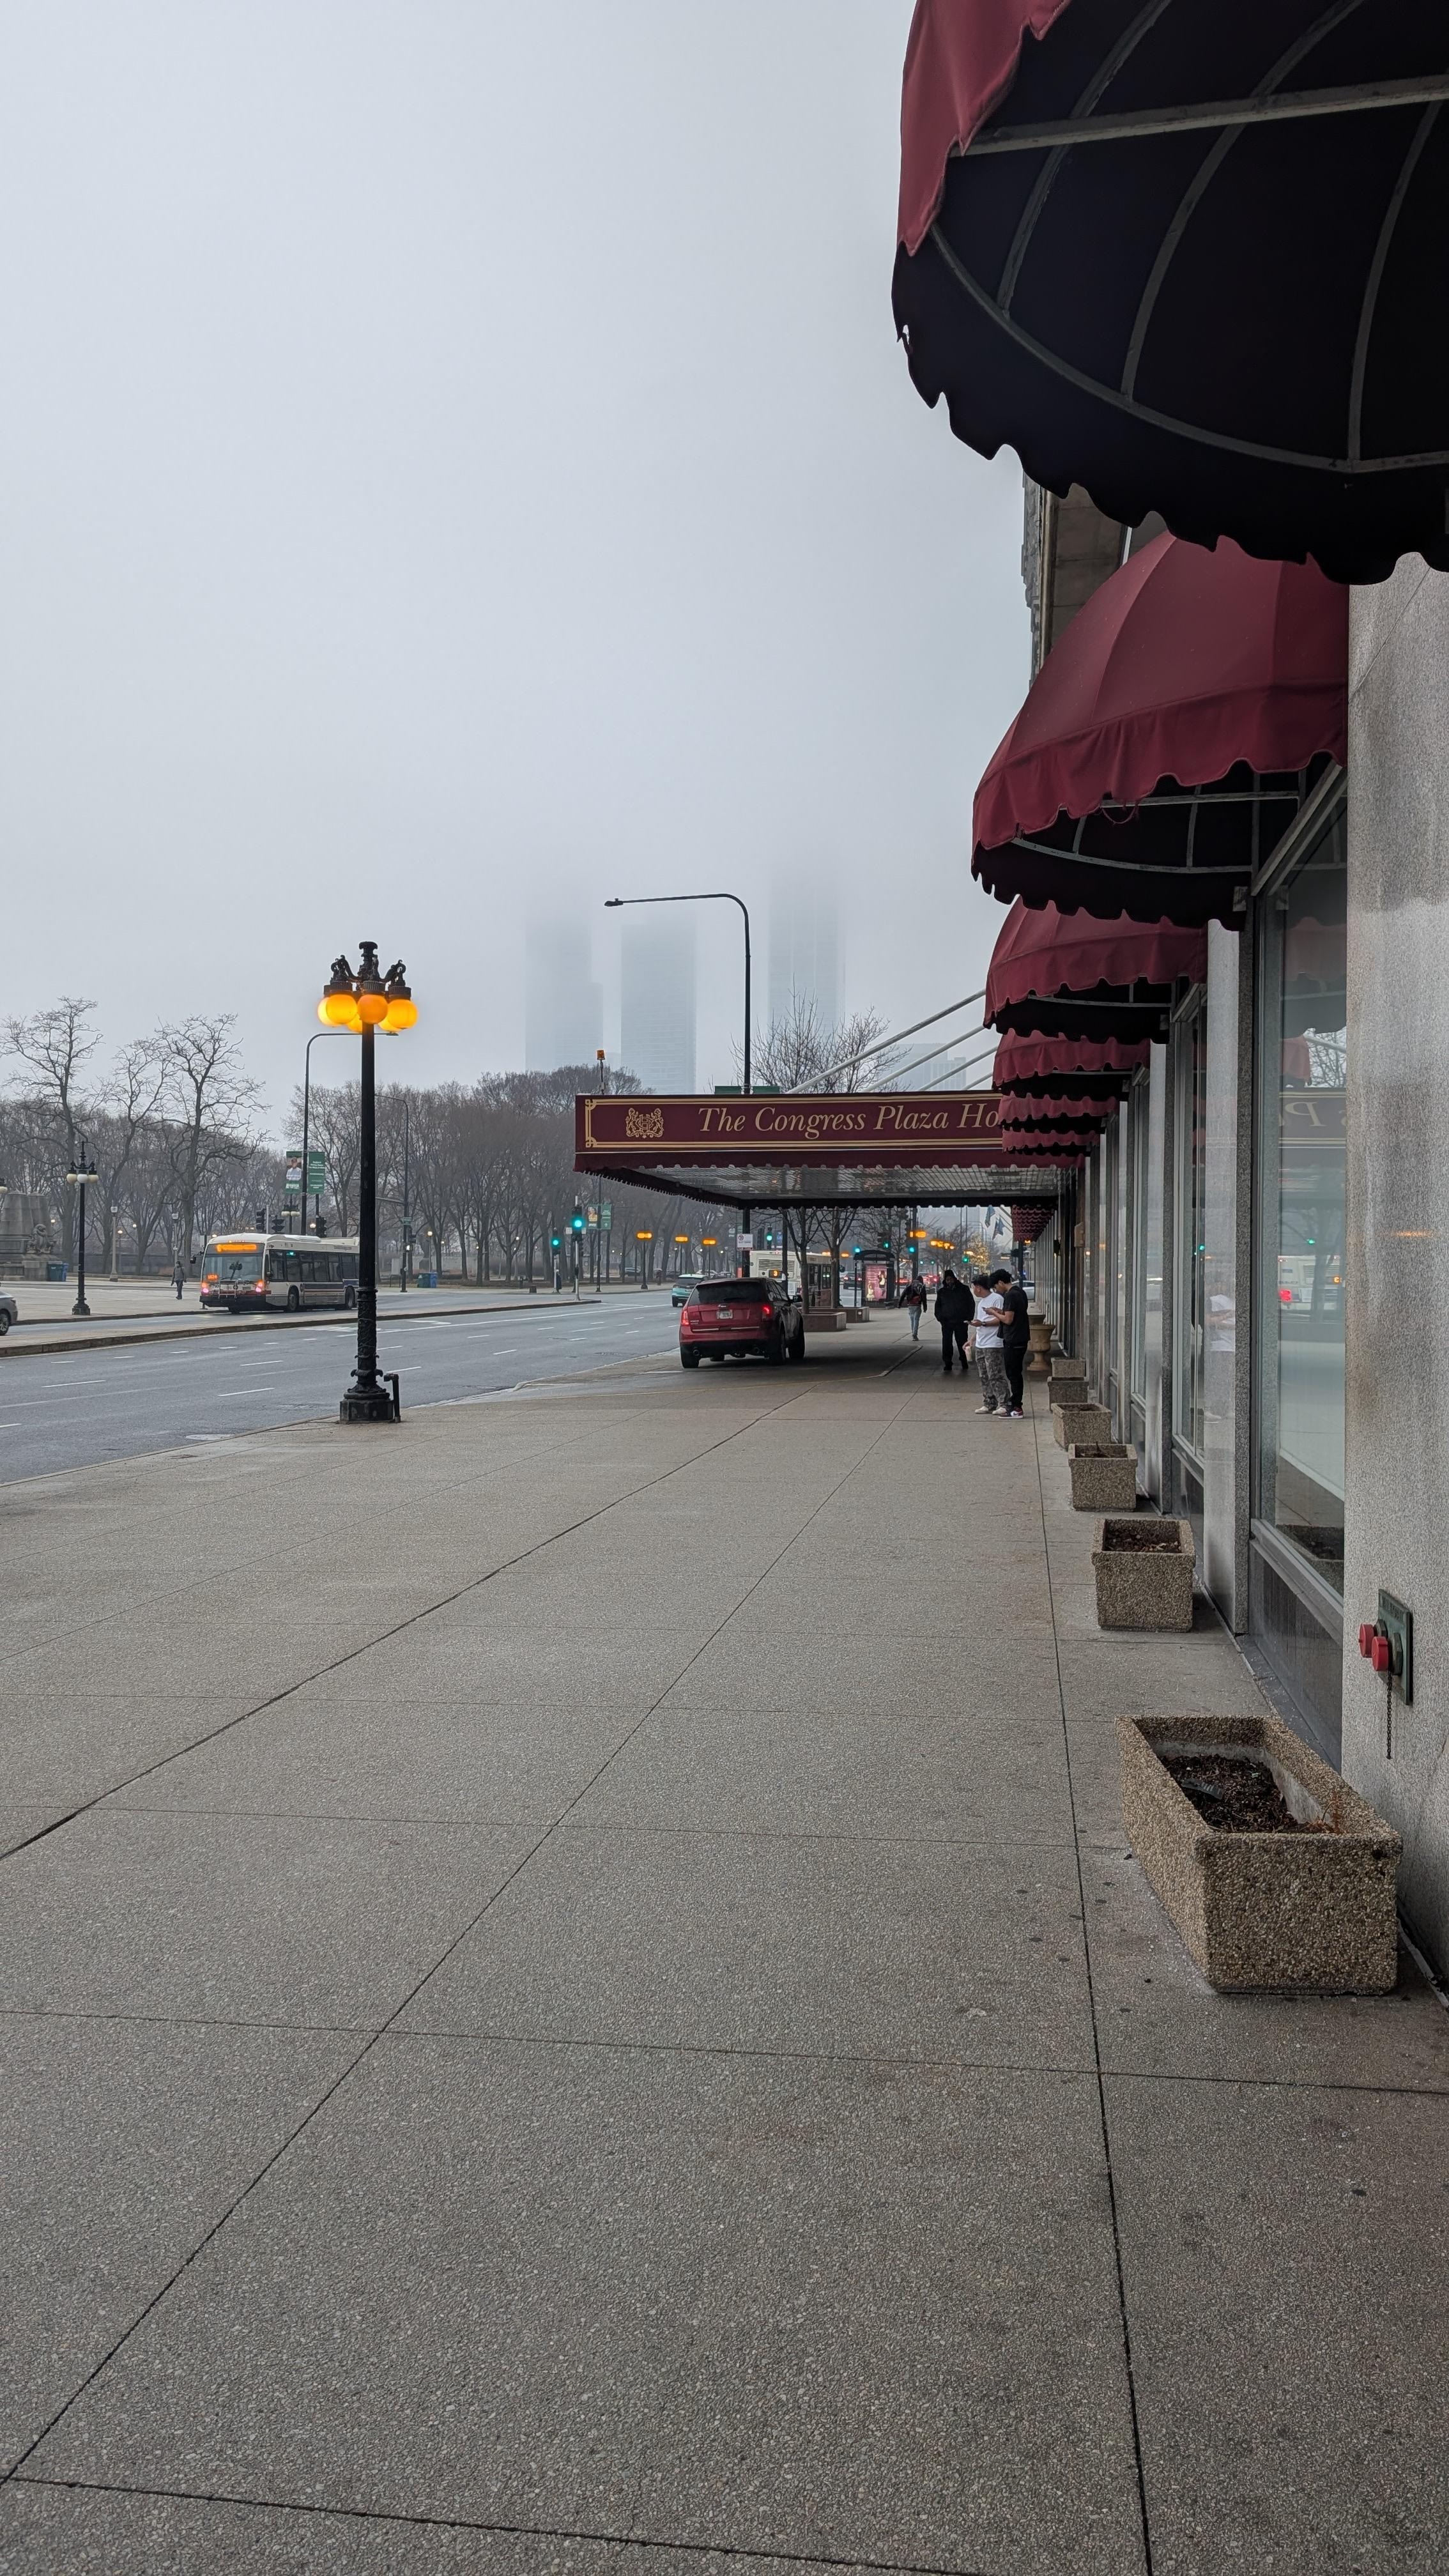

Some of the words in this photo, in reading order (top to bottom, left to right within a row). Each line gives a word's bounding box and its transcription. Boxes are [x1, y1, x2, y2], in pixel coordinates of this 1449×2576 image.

[698, 1107, 746, 1131] The
[755, 1107, 866, 1140] Congress
[873, 1105, 949, 1130] Plaza
